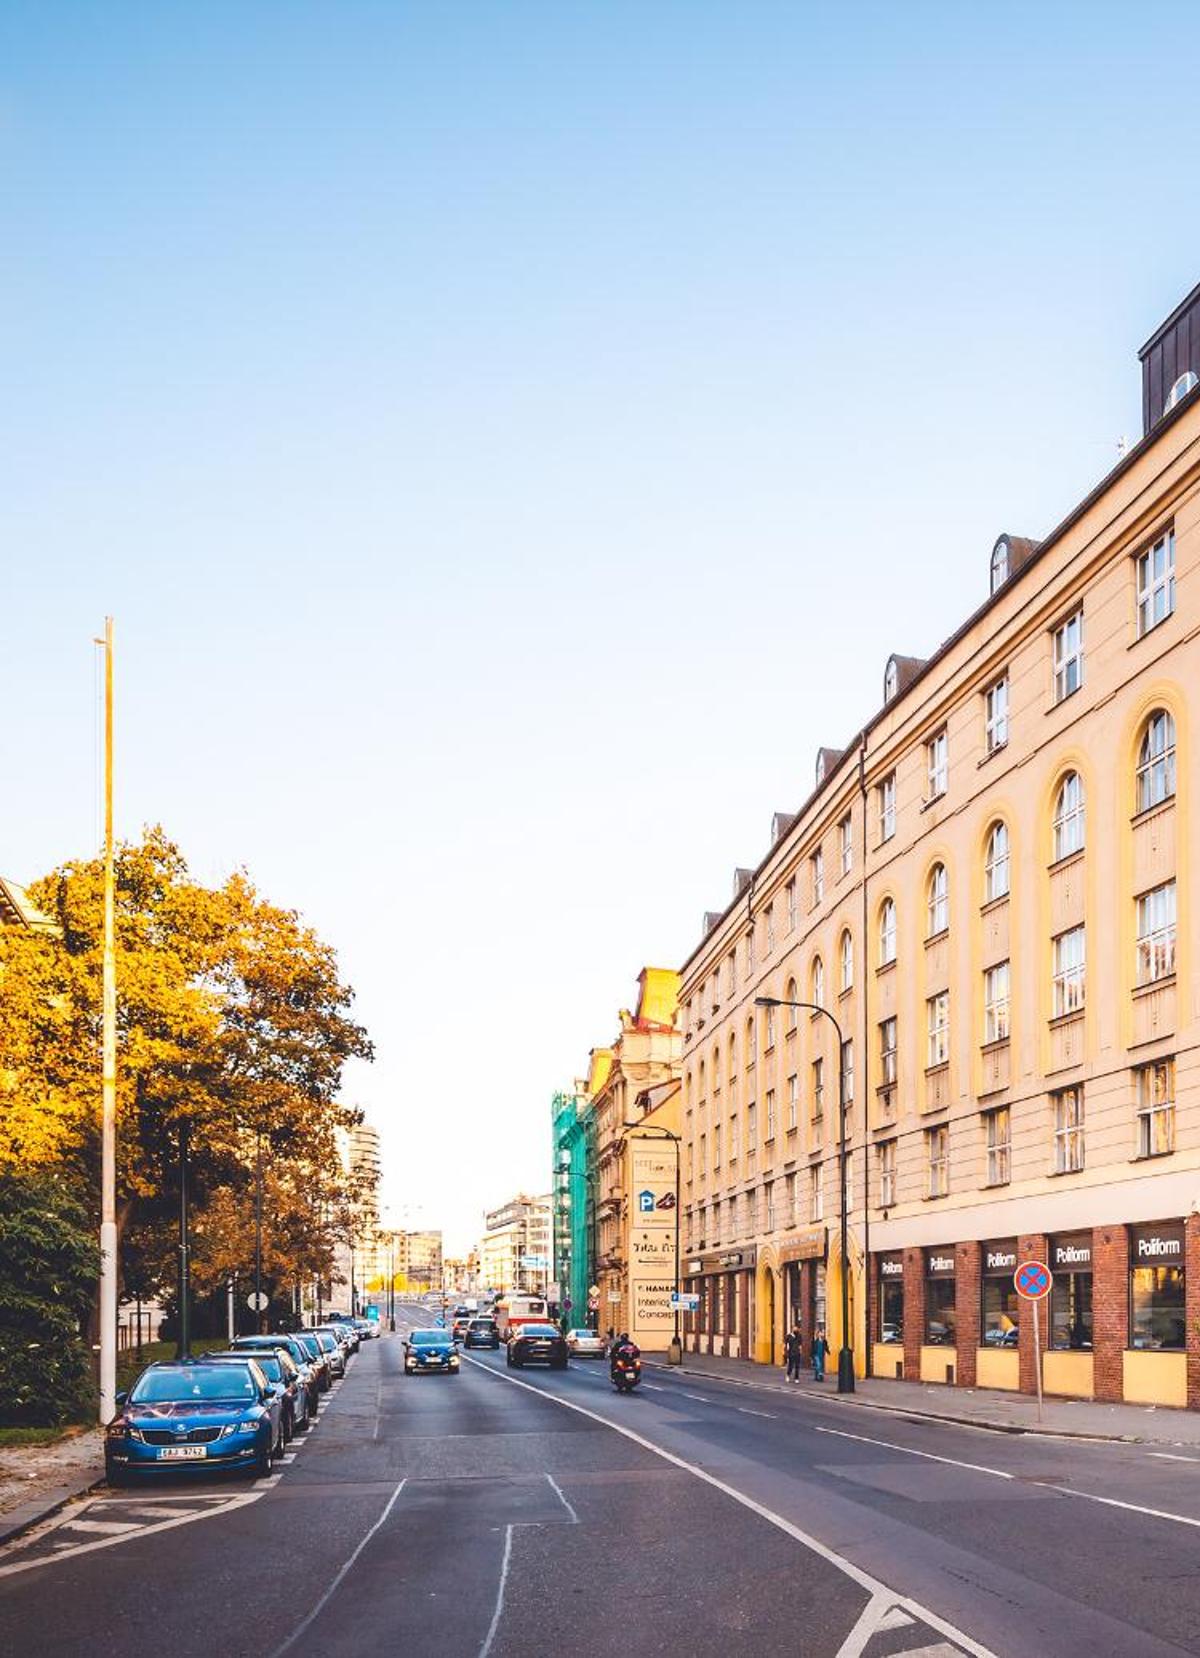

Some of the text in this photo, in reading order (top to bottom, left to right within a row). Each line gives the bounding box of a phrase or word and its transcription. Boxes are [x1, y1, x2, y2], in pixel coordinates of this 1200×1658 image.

[641, 1196, 653, 1211] P
[1056, 1246, 1091, 1263] Poliform
[1138, 1238, 1180, 1256] Poliform
[987, 1253, 1017, 1268] Poliform
[638, 1309, 675, 1319] Concep
